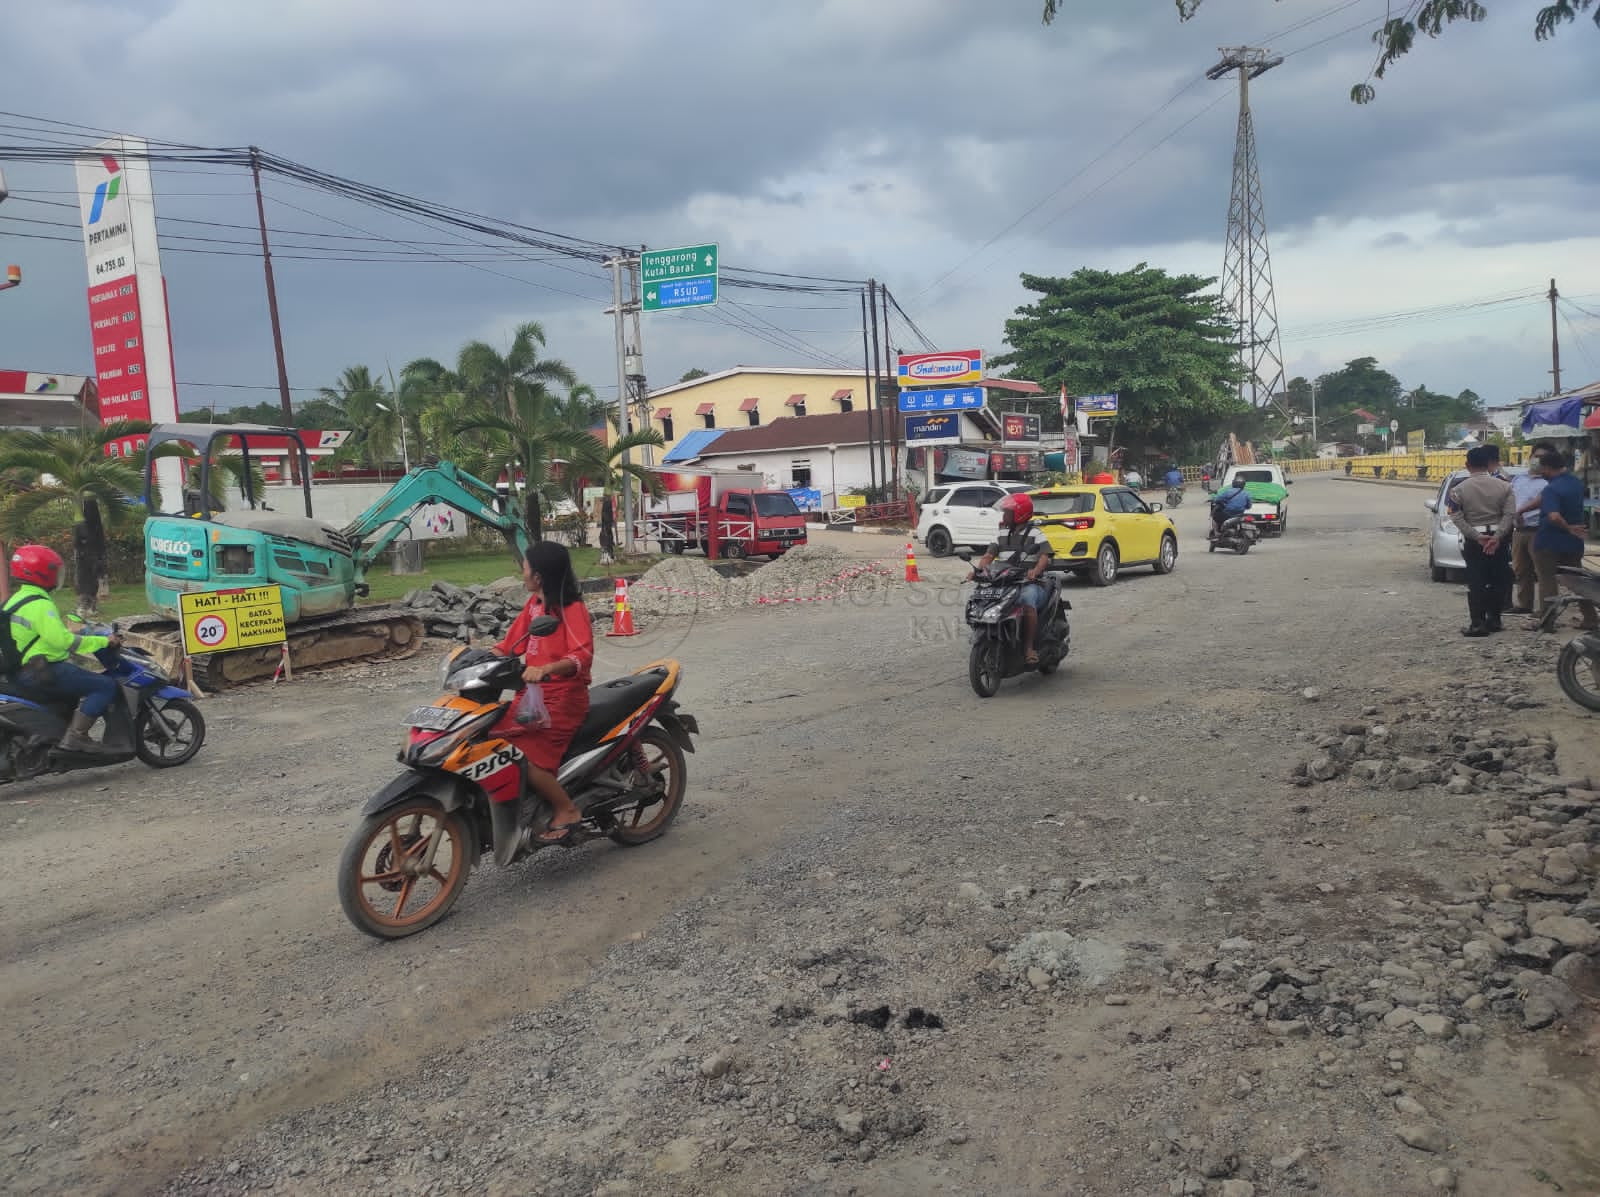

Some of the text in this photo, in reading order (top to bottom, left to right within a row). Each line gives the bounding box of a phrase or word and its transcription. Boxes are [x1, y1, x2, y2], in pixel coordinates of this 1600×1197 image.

[88, 222, 127, 246] PERTAMINA
[645, 253, 697, 267] Tenggarong
[645, 264, 695, 277] Kutai Barat
[674, 286, 698, 297] RSUD
[914, 362, 964, 376] Indomaret
[913, 423, 942, 433] mandiri
[195, 596, 221, 608] HATI
[232, 593, 256, 604] HATI
[259, 591, 270, 601] !!!
[249, 609, 272, 618] BATAS
[240, 617, 283, 628] KECEPATAN
[200, 626, 217, 639] 20
[241, 626, 284, 638] MAKSIMUM
